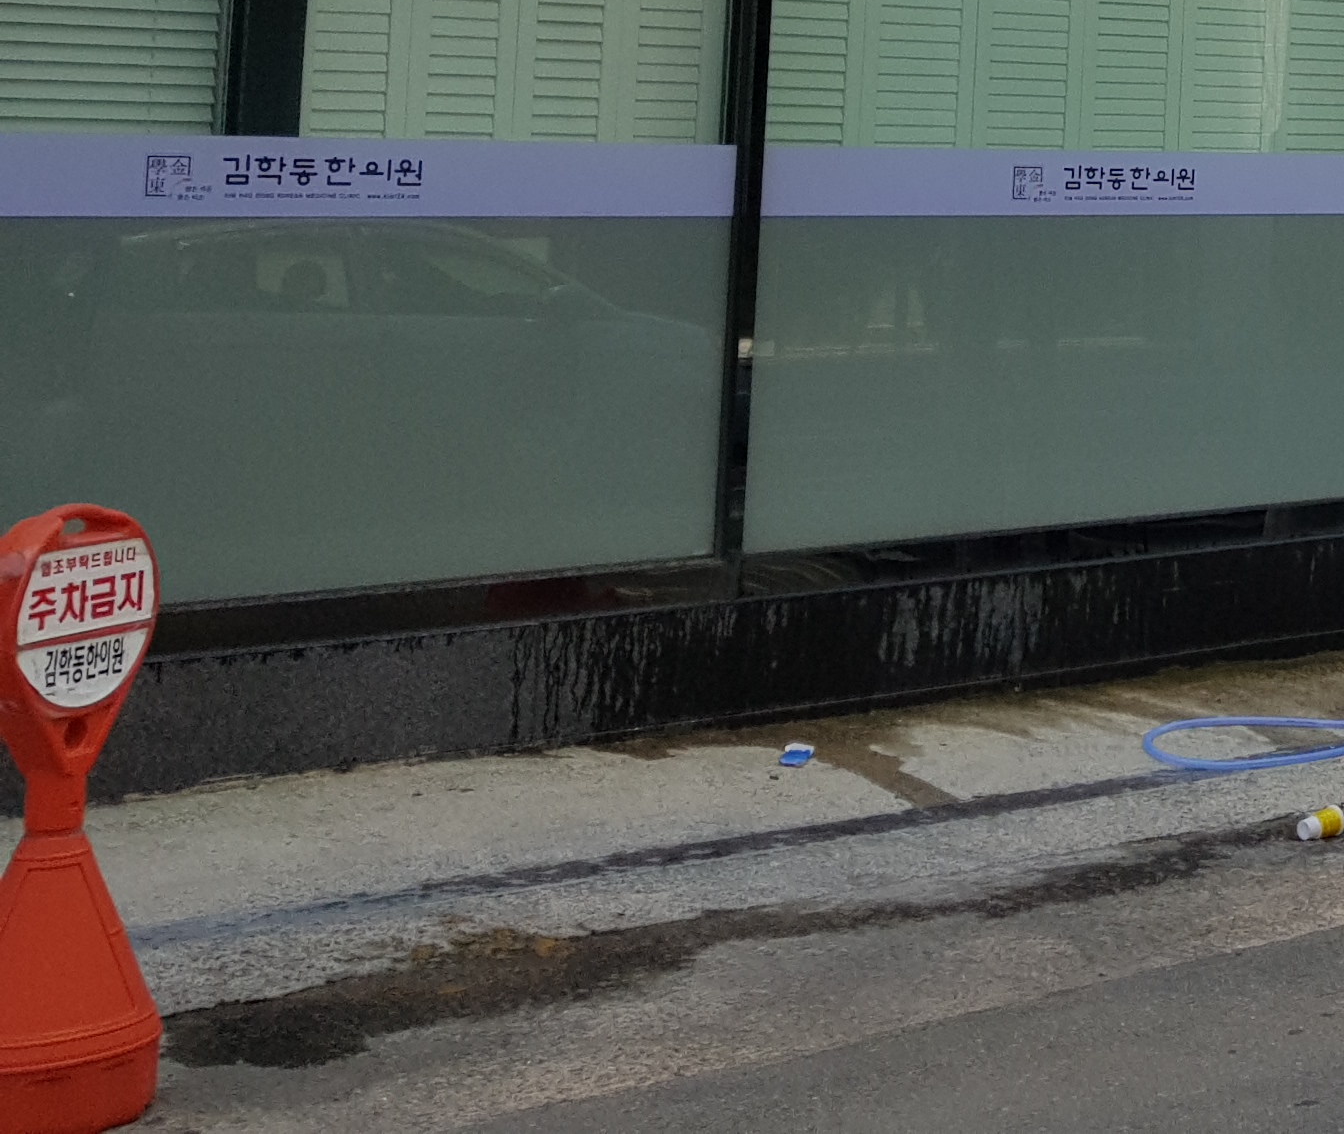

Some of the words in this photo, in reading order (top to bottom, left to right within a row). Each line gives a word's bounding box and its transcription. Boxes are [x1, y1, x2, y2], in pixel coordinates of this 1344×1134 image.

[223, 154, 423, 186] 김학동한의원
[1063, 165, 1196, 191] 김학동한의원
[28, 570, 144, 631] 주차금지
[45, 637, 124, 687] 김학동한의원
